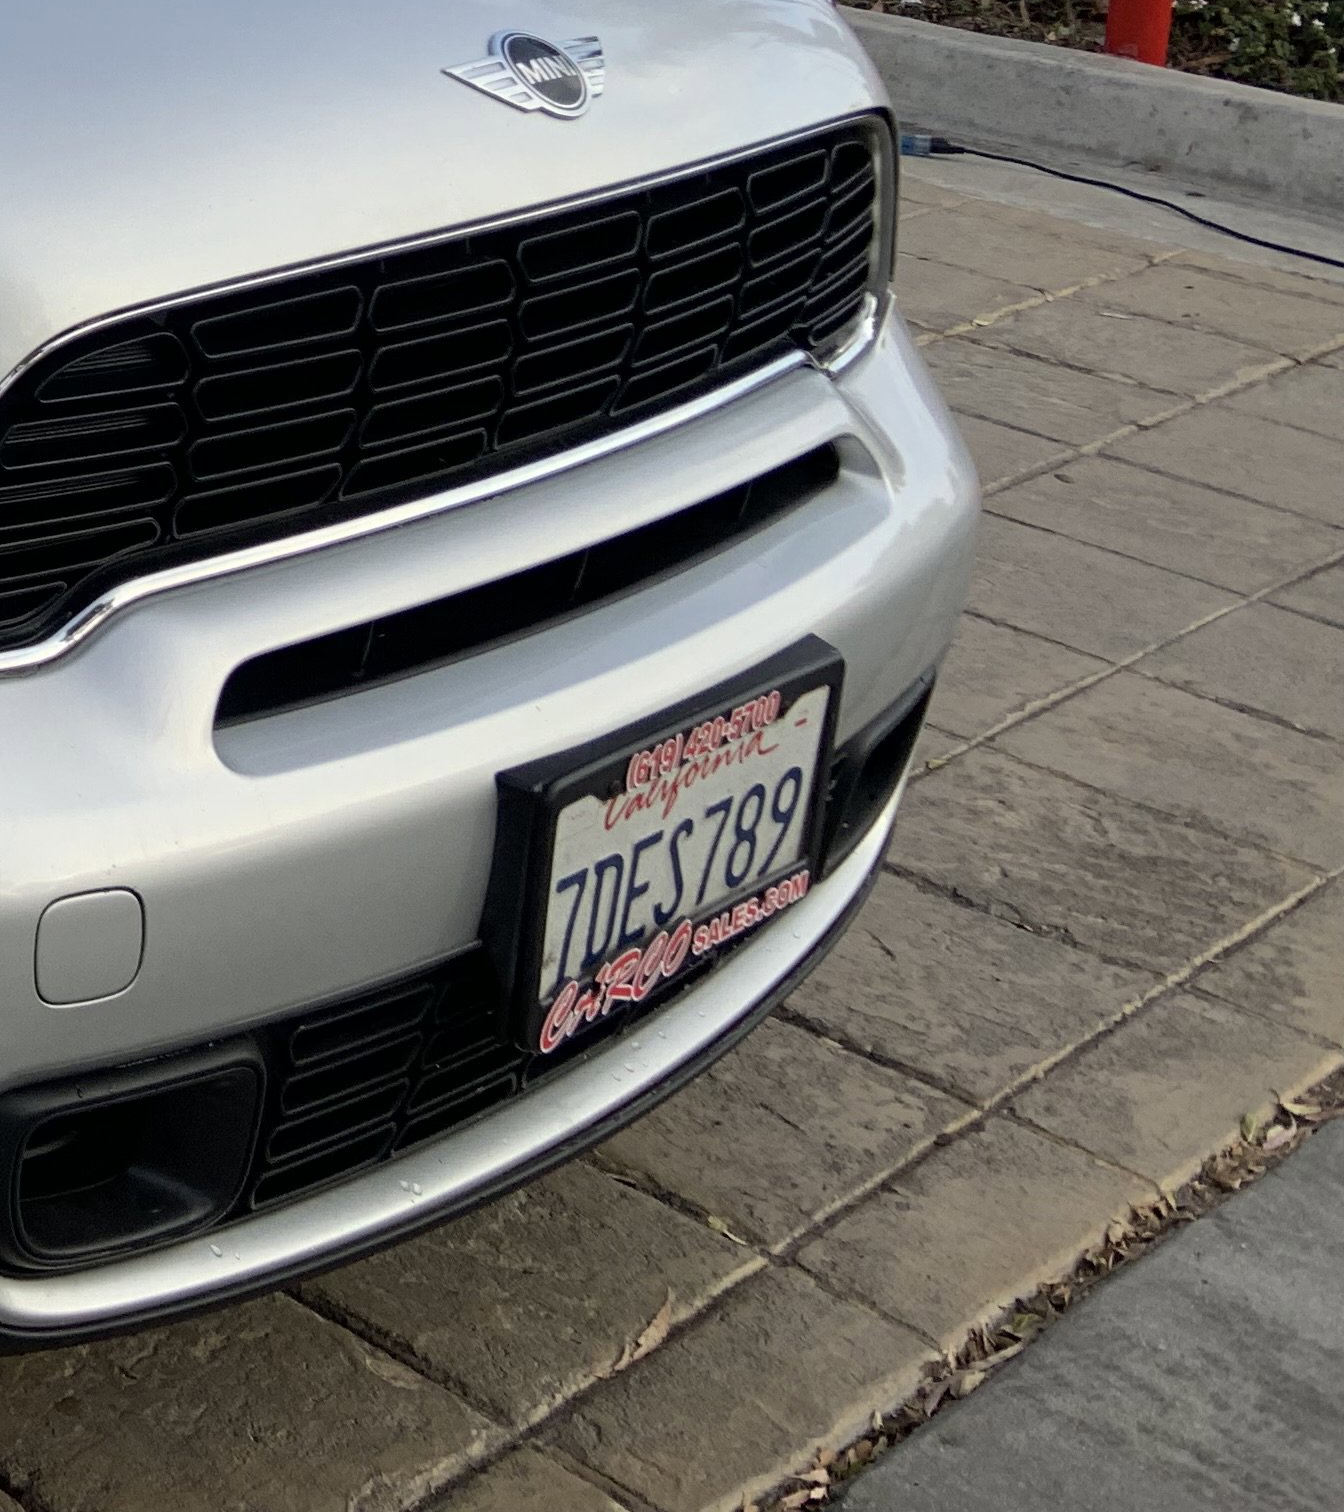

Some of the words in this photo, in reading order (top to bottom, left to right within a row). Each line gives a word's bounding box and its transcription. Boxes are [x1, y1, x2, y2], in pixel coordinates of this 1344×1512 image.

[516, 55, 578, 85] MINI
[604, 731, 779, 830] California
[626, 734, 683, 792] (619)
[683, 690, 780, 760] 420-5700
[556, 766, 803, 985] 7DES789
[692, 870, 811, 955] SALES.COM
